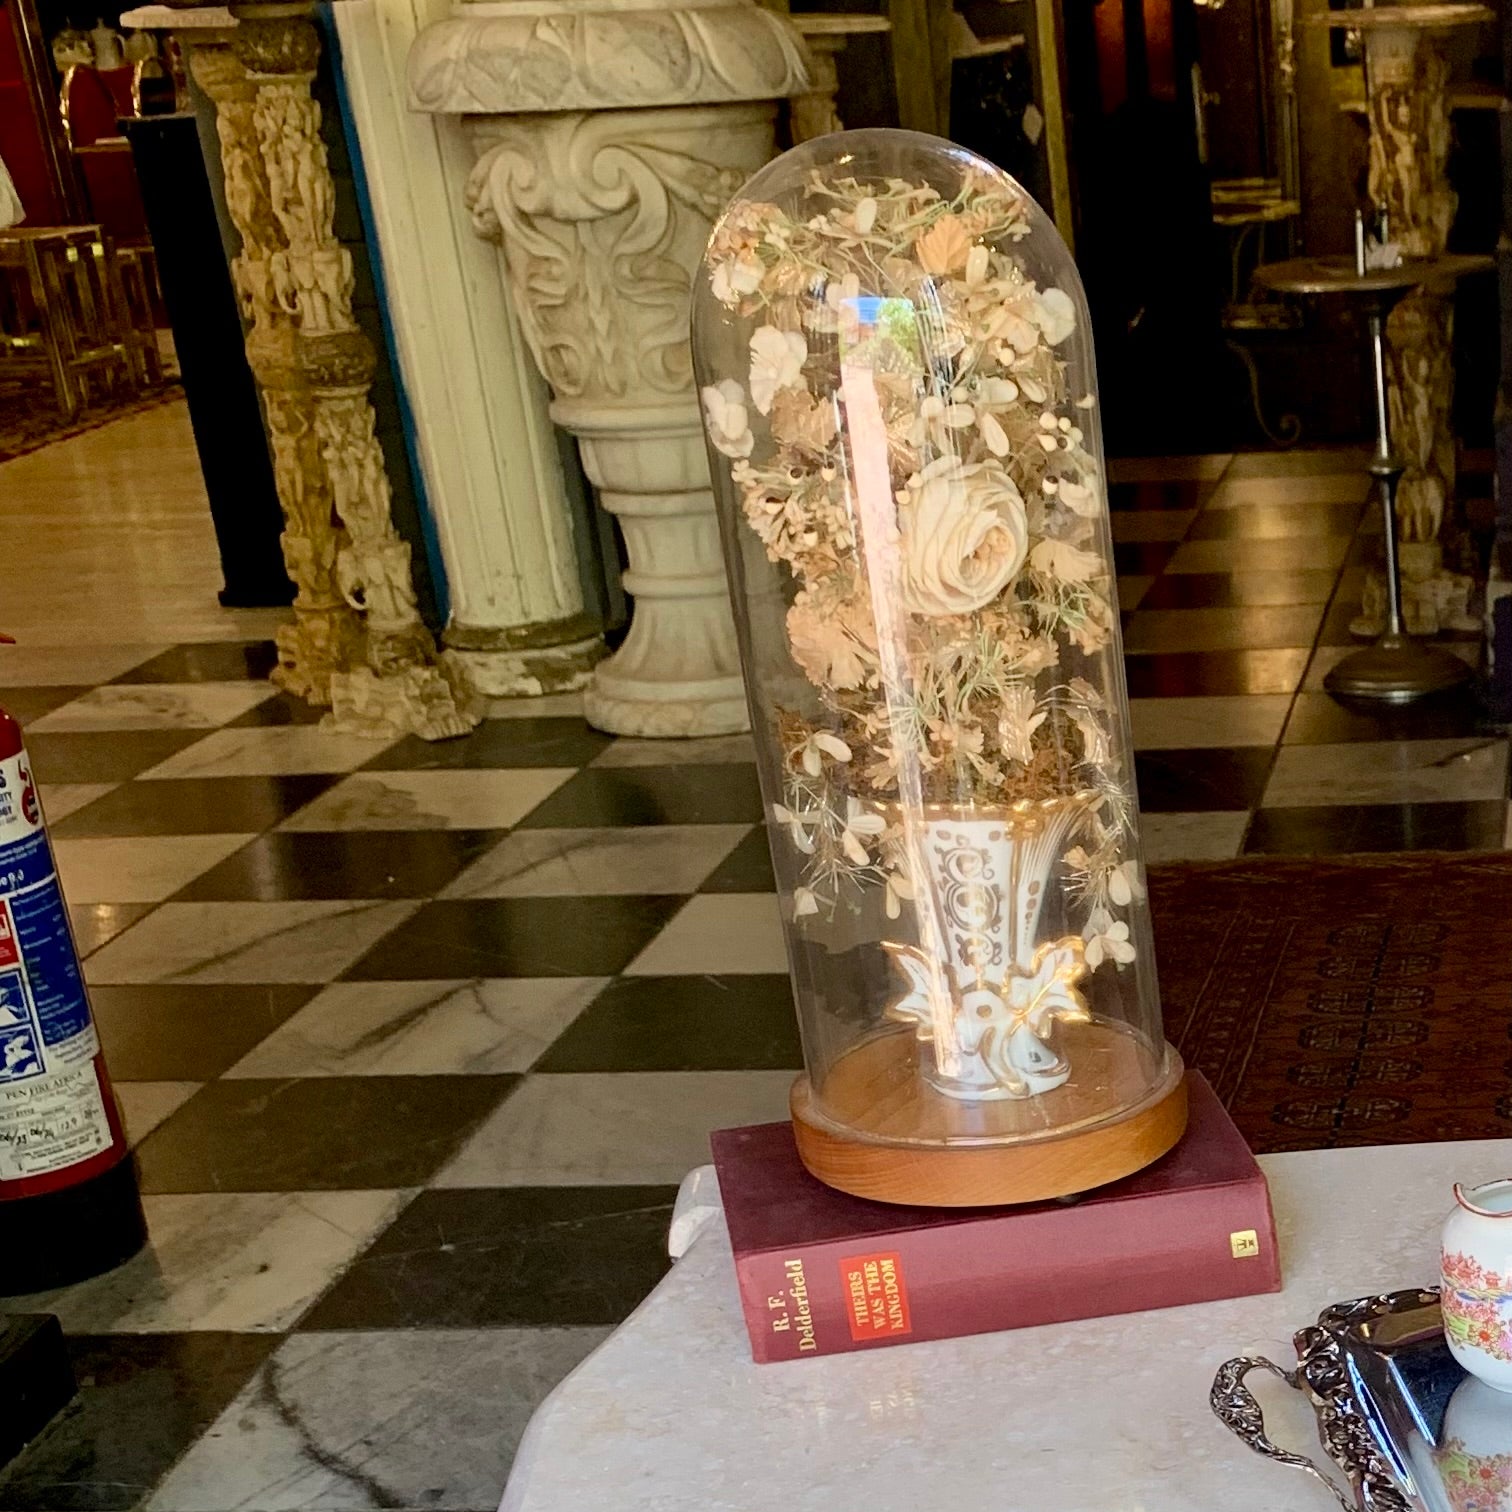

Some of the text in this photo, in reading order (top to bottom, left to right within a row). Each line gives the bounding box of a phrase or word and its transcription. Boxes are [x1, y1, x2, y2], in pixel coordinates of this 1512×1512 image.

[784, 1258, 817, 1352] Delderfield
[848, 1271, 869, 1327] THEIRS
[864, 1260, 887, 1329] WAS THE
[880, 1258, 904, 1330] KINGDOM
